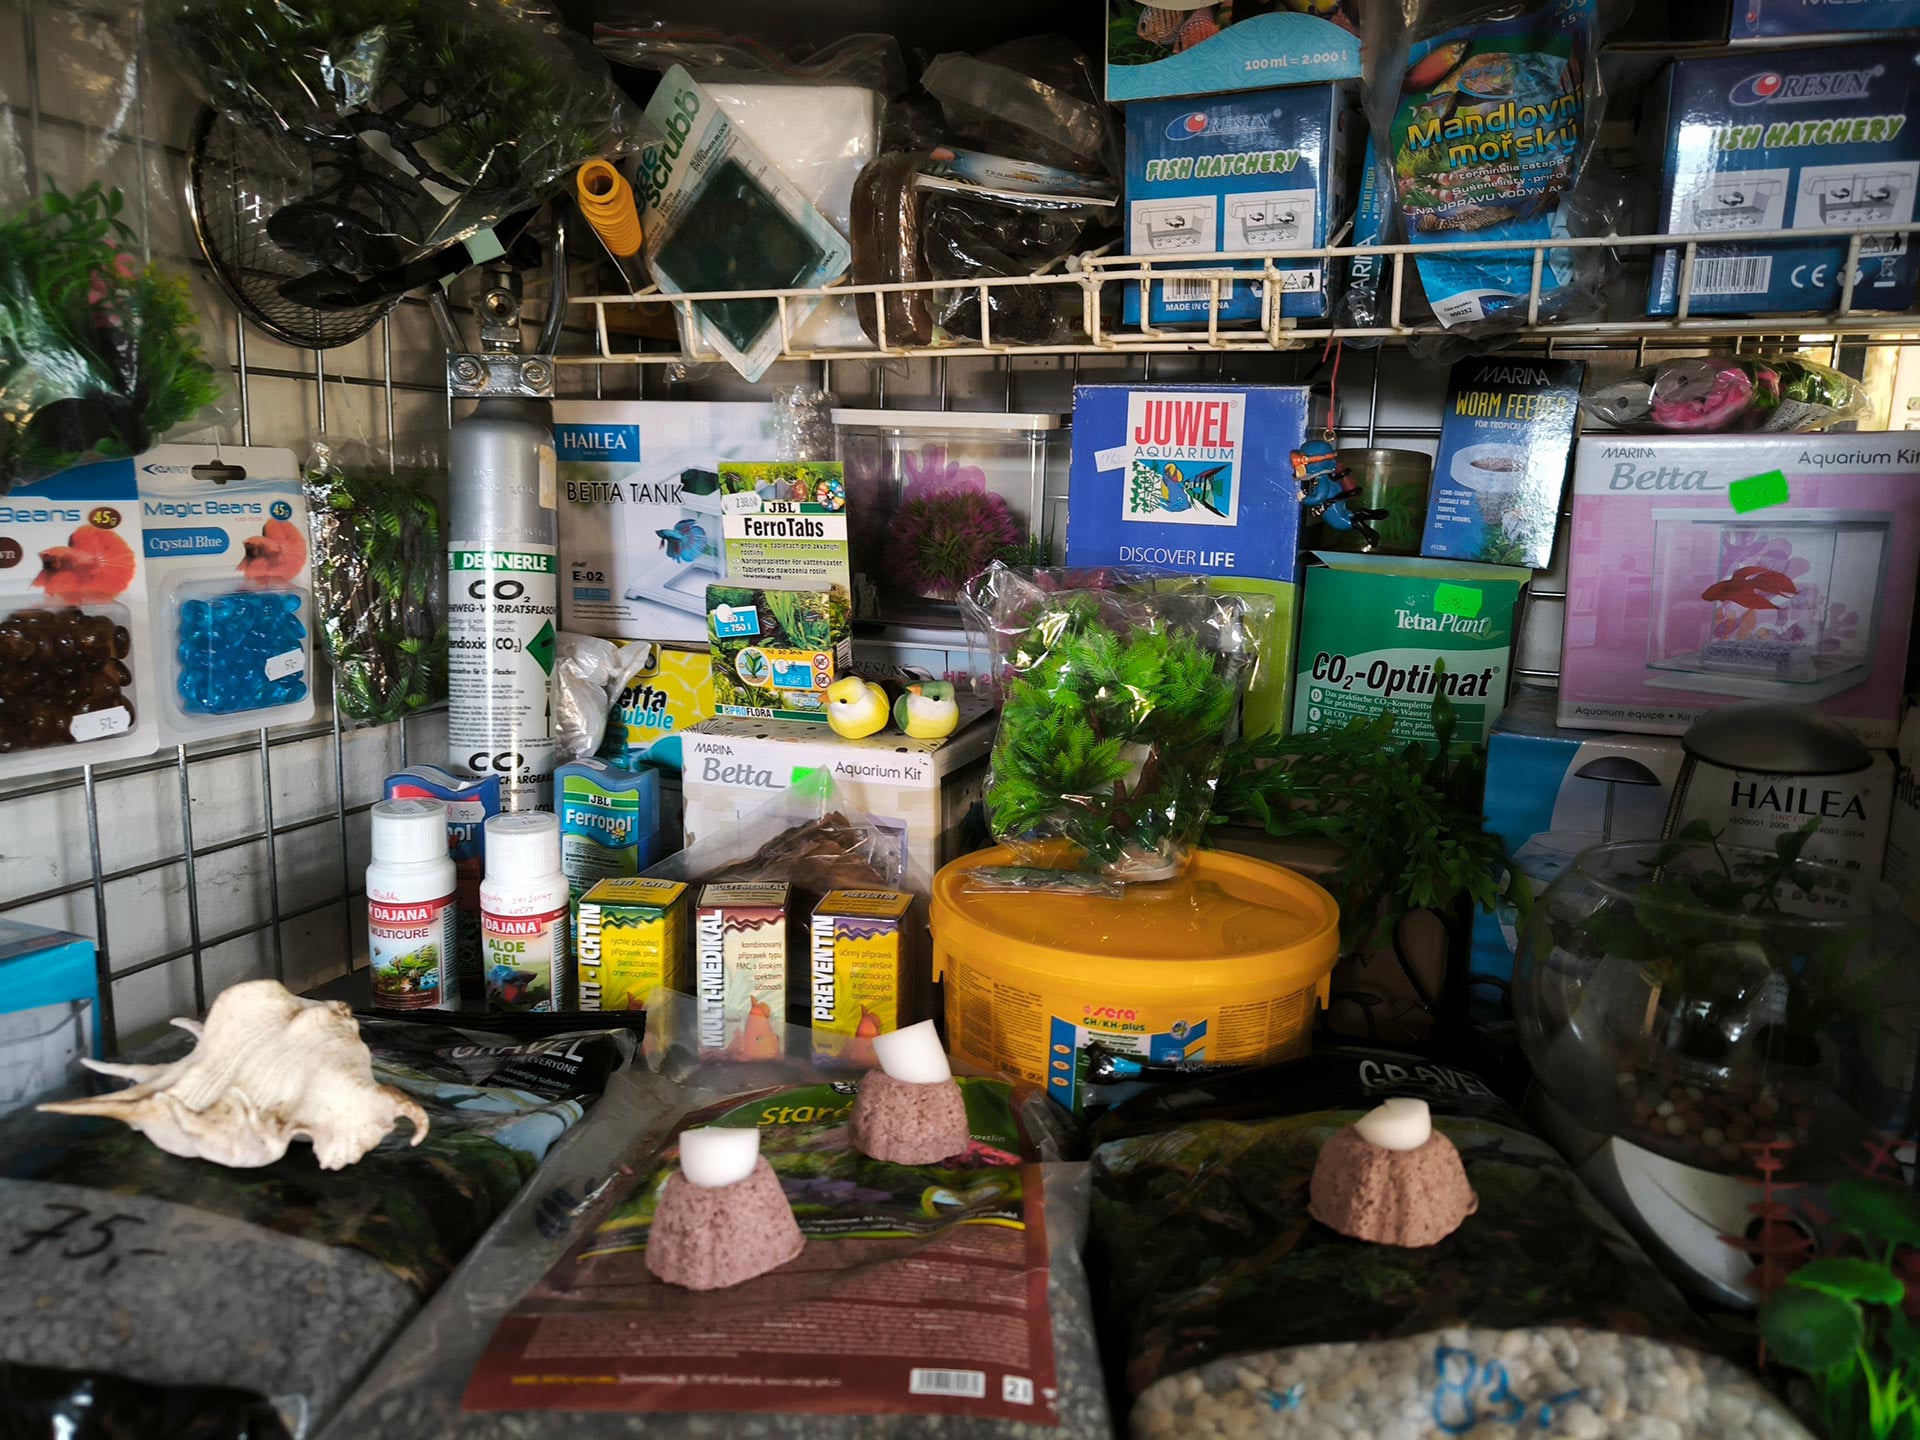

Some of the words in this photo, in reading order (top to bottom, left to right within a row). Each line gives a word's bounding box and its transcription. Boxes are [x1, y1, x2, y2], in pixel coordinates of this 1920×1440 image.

[1302, 53, 1338, 66] 2.000
[1781, 73, 1869, 98] RESUN
[1207, 113, 1271, 133] RESUN
[1406, 86, 1585, 151] Mandlovní
[1709, 124, 1763, 151] ISH
[1764, 115, 1906, 148] HATCHERY
[646, 91, 700, 210] scrubb
[1448, 120, 1578, 168] mořský
[1147, 157, 1194, 181] FISH
[1195, 149, 1301, 178] HATCHERY
[1416, 206, 1435, 216] NA
[1437, 192, 1496, 213] ÚPRAVU
[1498, 188, 1535, 200] VODY
[1166, 303, 1190, 312] MADE
[1192, 302, 1200, 310] IN
[1201, 302, 1230, 311] CNA
[1474, 366, 1551, 386] MARINA
[1456, 391, 1502, 418] WORM
[1135, 400, 1235, 448] JUWEL
[1474, 419, 1488, 429] FOR
[1490, 421, 1521, 431] TROPICAL
[563, 432, 627, 449] HAILEA
[1134, 446, 1234, 460] AQUARIUM
[1602, 447, 1656, 459] MARINA
[1798, 450, 1891, 469] Aquarium
[1609, 462, 1725, 491] Betta
[567, 481, 624, 503] BETTA
[629, 482, 685, 505] TANK
[144, 501, 204, 518] Magic
[206, 501, 262, 514] Beans
[769, 502, 796, 513] JBL
[744, 518, 824, 537] FerroTabs
[150, 535, 193, 550] Crystal
[195, 534, 222, 548] Blue
[463, 552, 547, 571] DENNERLE
[1119, 546, 1196, 565] DISCOVER
[1200, 551, 1235, 568] LIFE
[572, 571, 604, 582] E-02
[621, 683, 667, 713] etta
[1324, 690, 1336, 698] Das
[1337, 691, 1373, 704] praktische
[1324, 698, 1333, 706] für
[612, 703, 674, 731] Bubble
[730, 706, 772, 718] PROFLORA
[1575, 706, 1624, 717] Aquarium
[1400, 720, 1414, 728] des
[1411, 729, 1437, 738] bonne
[694, 742, 735, 755] MARINA
[702, 757, 786, 789] Betta
[835, 761, 901, 780] Aquarium
[903, 765, 922, 781] Kit
[590, 794, 610, 807] JBL
[1731, 781, 1866, 821] HAILEA
[566, 808, 633, 833] Ferropol
[373, 908, 428, 922] DAJANA
[370, 927, 429, 939] MULTICURE
[485, 918, 537, 934] DAJANA
[579, 903, 601, 967] ICHTIN
[488, 938, 526, 953] ALOE
[493, 952, 520, 966] GEL
[814, 916, 836, 1021] PREVENTIN
[1093, 1006, 1136, 1021] sera
[527, 1056, 579, 1076] EVERYONE
